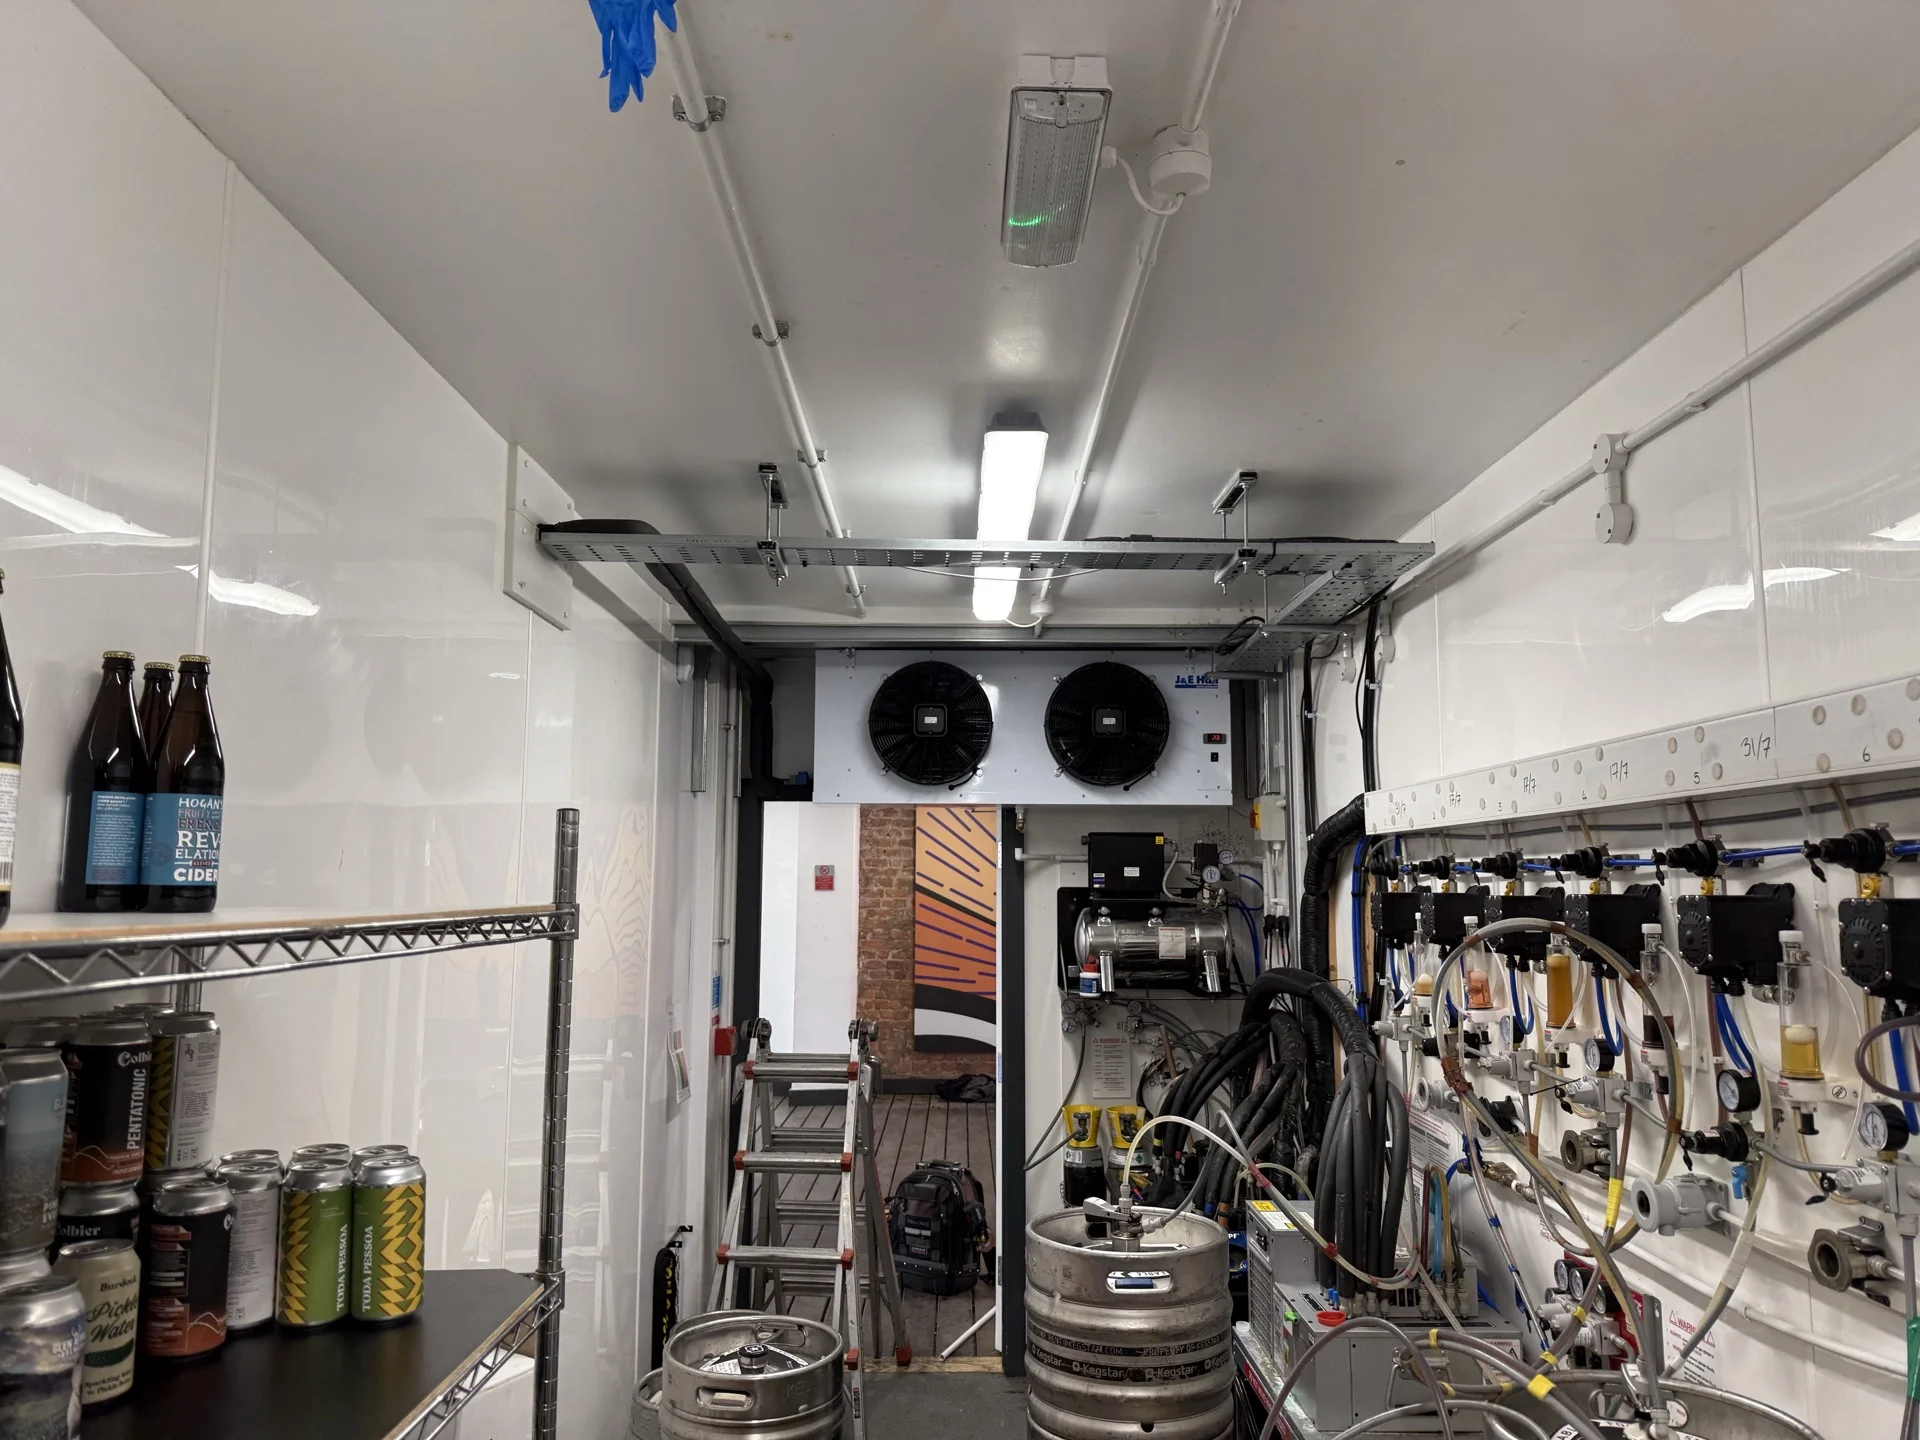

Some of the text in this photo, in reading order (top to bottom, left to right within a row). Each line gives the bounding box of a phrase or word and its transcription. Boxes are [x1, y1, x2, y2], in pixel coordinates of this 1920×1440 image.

[1175, 675, 1194, 685] J&E
[1741, 733, 1771, 760] 31/7
[1862, 744, 1871, 762] 6
[1609, 760, 1629, 782] 17/7
[1693, 771, 1701, 784] 5
[1582, 790, 1588, 800] 4
[178, 808, 211, 819] FRUITY
[1497, 801, 1503, 812] 3
[177, 819, 221, 831] FRENC
[127, 1068, 146, 1150] PENTATONIC
[337, 1224, 348, 1311] TODA PESSOA
[362, 1226, 373, 1312] TODA PESSOA
[1036, 1347, 1062, 1367] Kegstar
[1082, 1363, 1124, 1379] Kegstar
[1157, 1365, 1195, 1380] Kegstar
